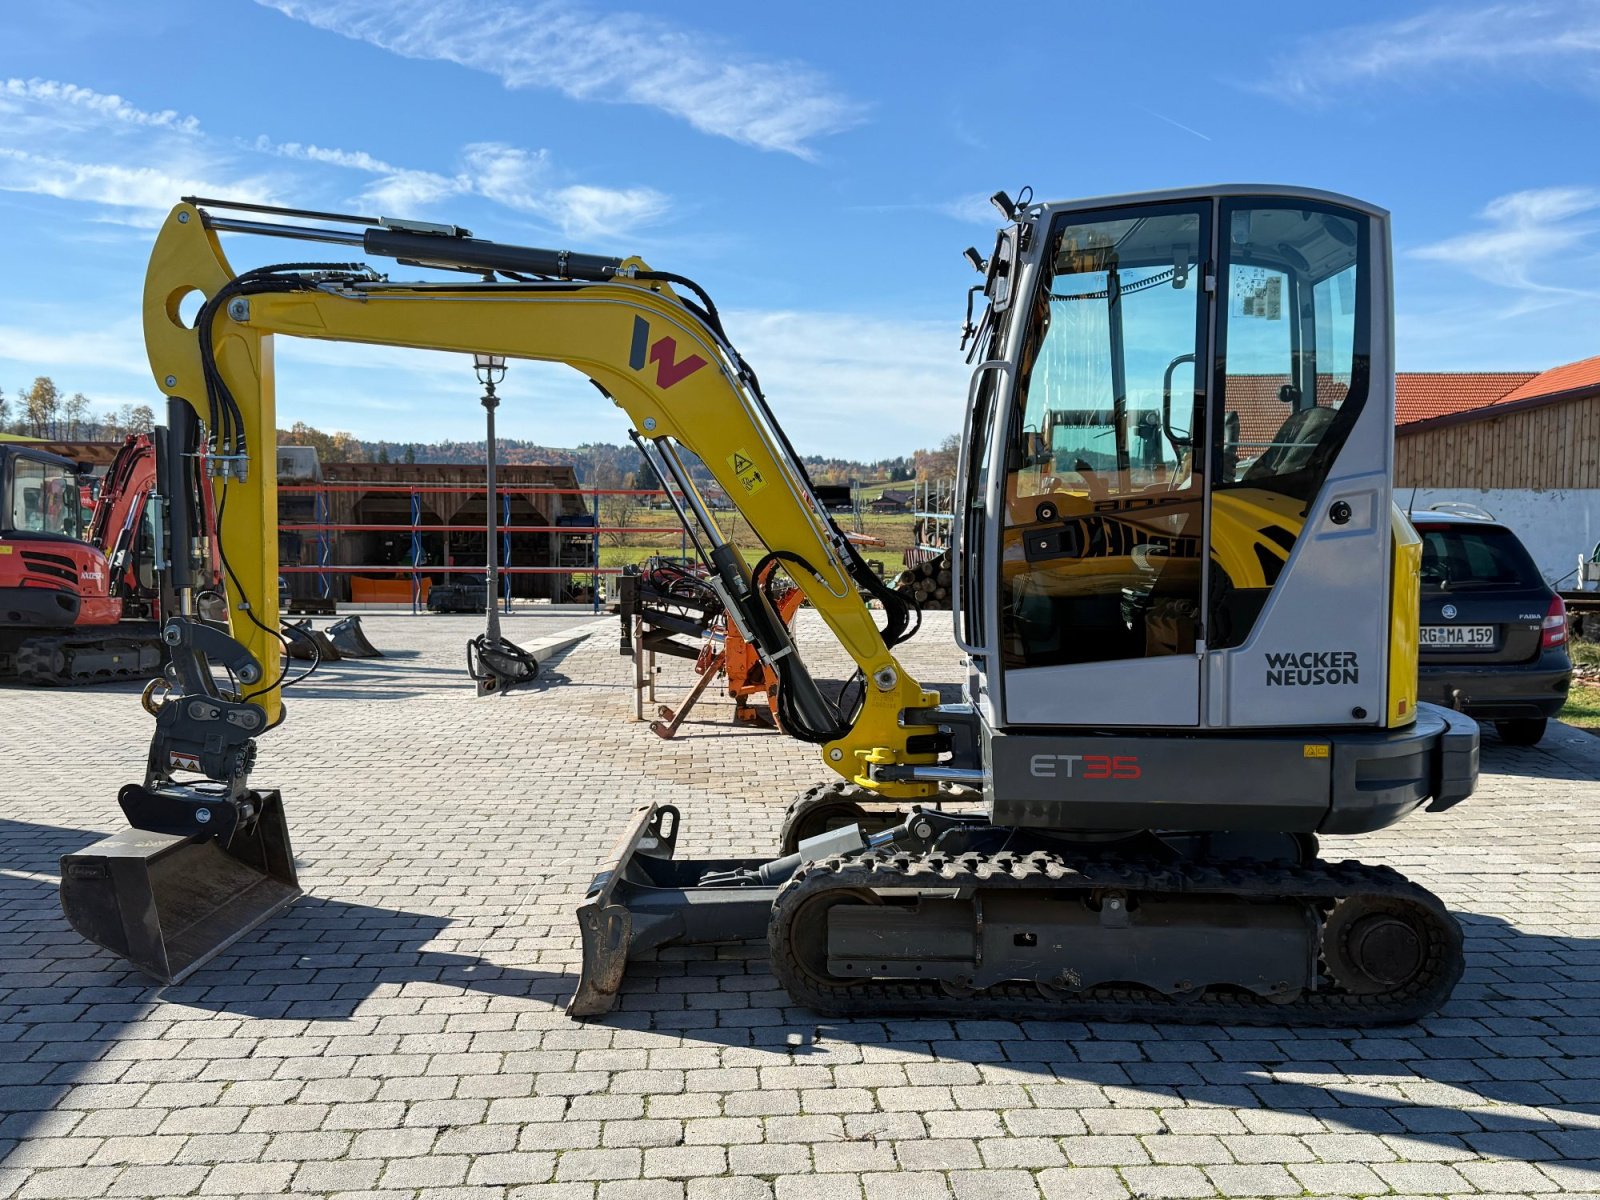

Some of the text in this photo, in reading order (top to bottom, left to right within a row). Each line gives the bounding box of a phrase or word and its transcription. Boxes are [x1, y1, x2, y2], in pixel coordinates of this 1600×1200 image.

[1419, 628, 1493, 643] RG MA 159
[1264, 652, 1359, 669] WACKER
[1266, 668, 1359, 686] NEUSON
[1030, 754, 1142, 779] ET35
